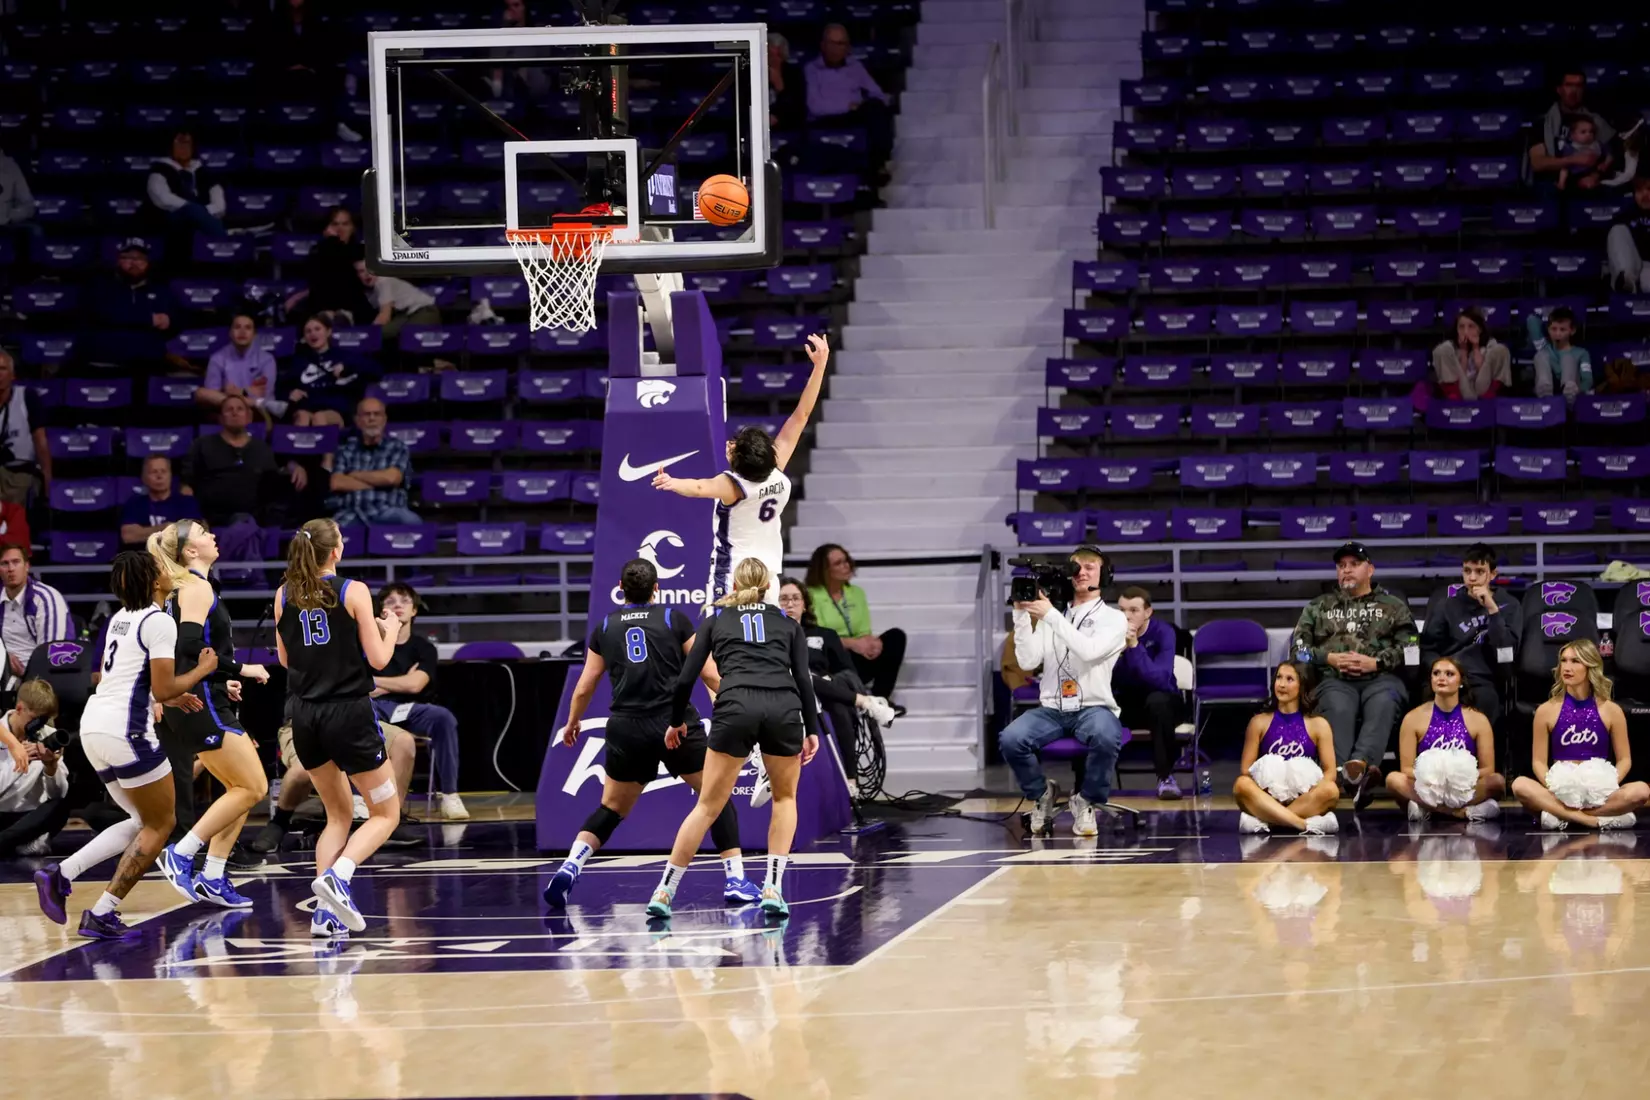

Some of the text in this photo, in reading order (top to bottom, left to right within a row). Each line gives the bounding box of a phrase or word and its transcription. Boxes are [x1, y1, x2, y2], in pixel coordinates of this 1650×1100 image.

[392, 251, 430, 261] SPALDING
[758, 480, 785, 500] GARCIA
[758, 498, 778, 523] 6
[620, 611, 649, 622] MACKEY
[1327, 608, 1383, 620] WILDCATS
[298, 607, 331, 647] 13
[740, 613, 765, 643] 11
[625, 626, 648, 663] 8
[104, 639, 118, 673] 3
[1269, 735, 1304, 757] Cats
[1560, 724, 1598, 746] Cats
